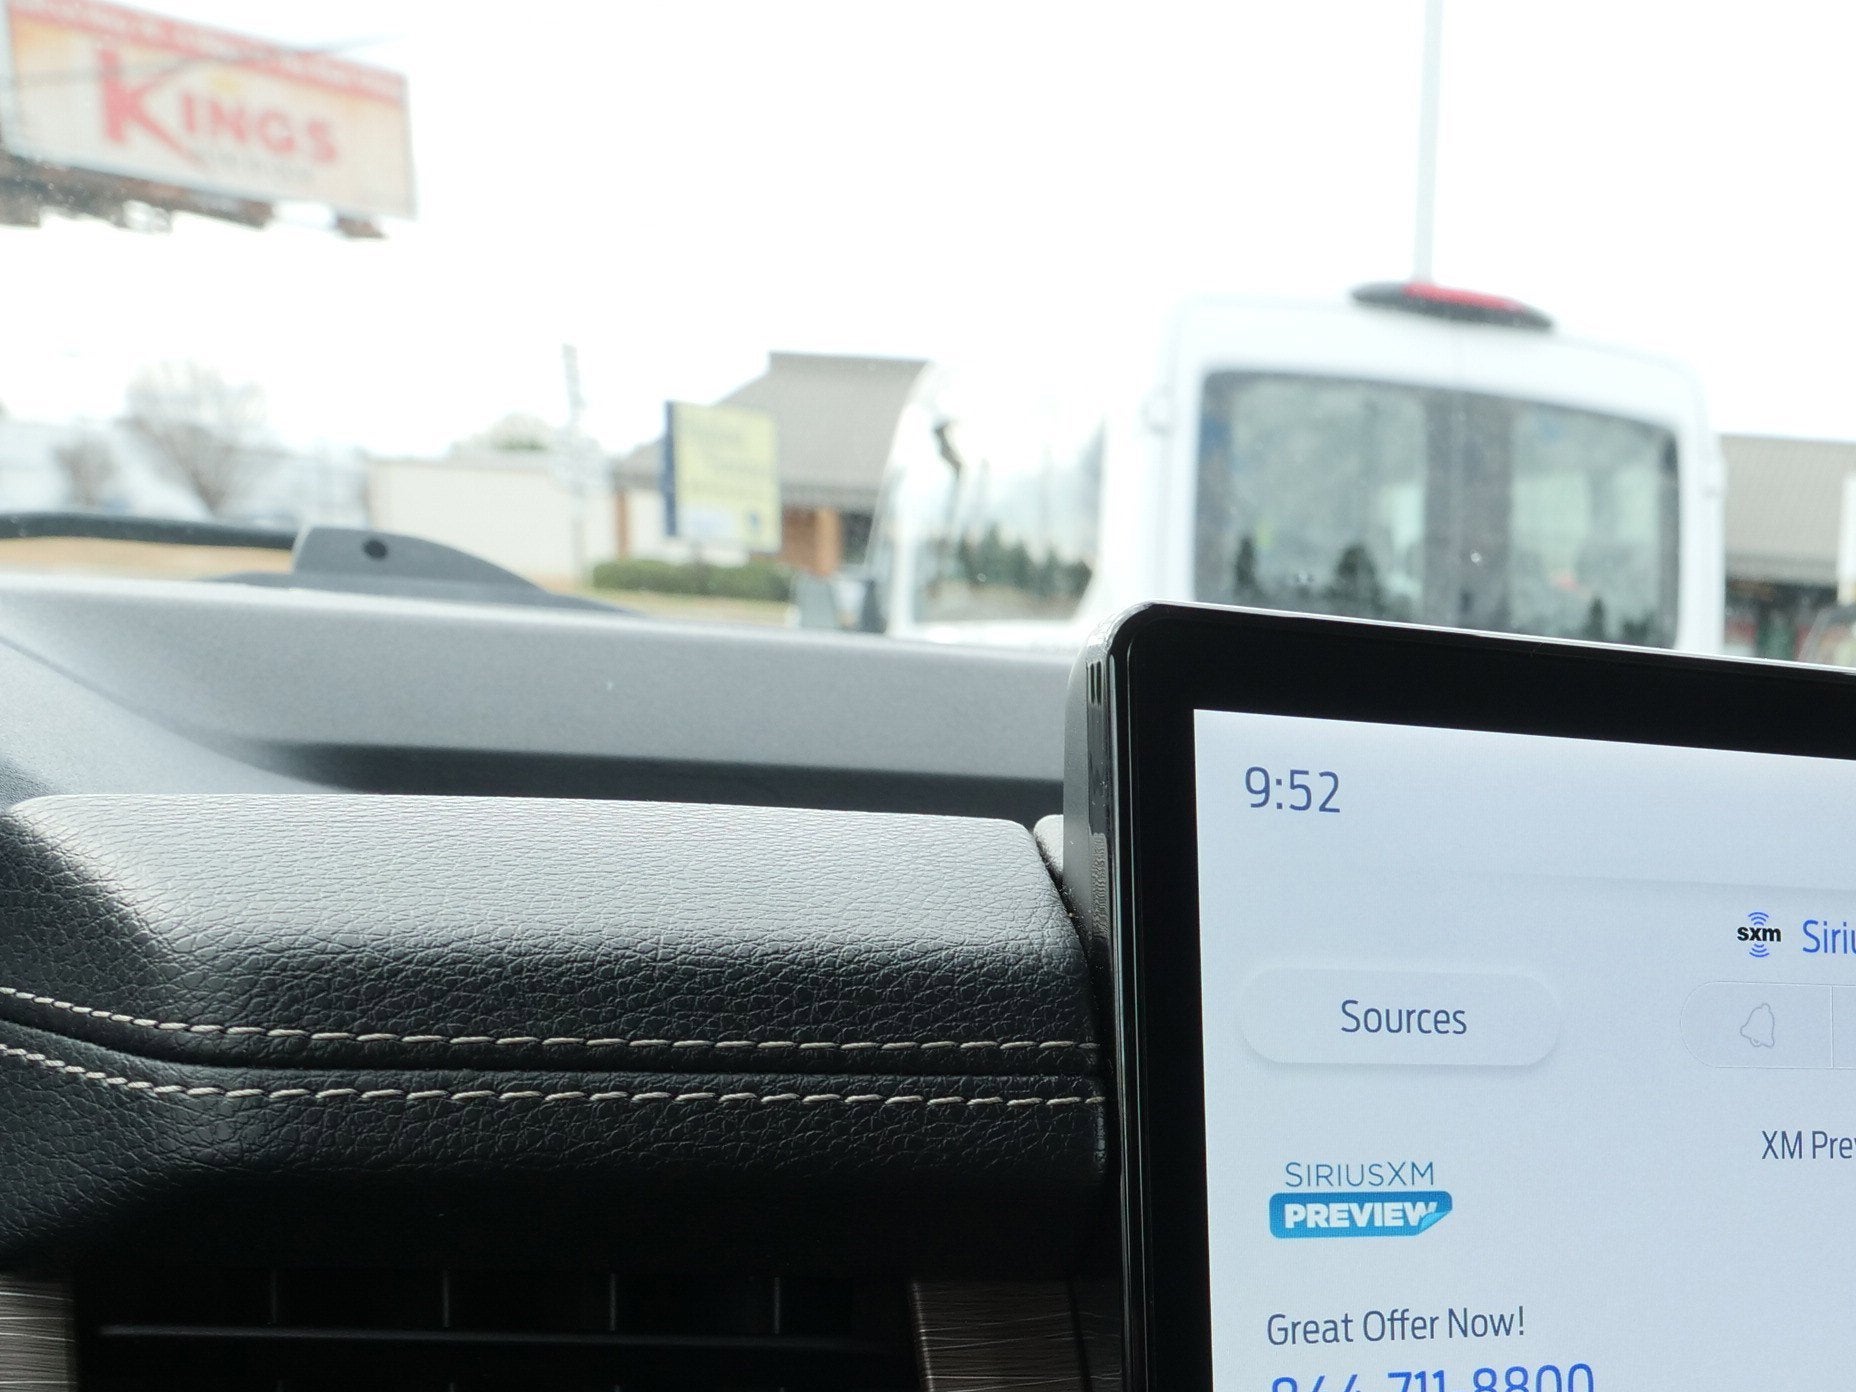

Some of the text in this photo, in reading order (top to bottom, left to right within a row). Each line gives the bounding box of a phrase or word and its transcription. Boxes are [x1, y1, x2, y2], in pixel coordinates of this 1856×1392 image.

[98, 48, 337, 172] KINGS
[1244, 766, 1342, 814] 9:52
[1737, 926, 1782, 944] sxm
[1341, 999, 1468, 1037] Sources
[1761, 1131, 1801, 1160] XM
[1285, 1161, 1435, 1189] SIRIUSXM
[1285, 1202, 1438, 1229] PREVIEW
[1267, 1305, 1526, 1347] Great Offer Now!
